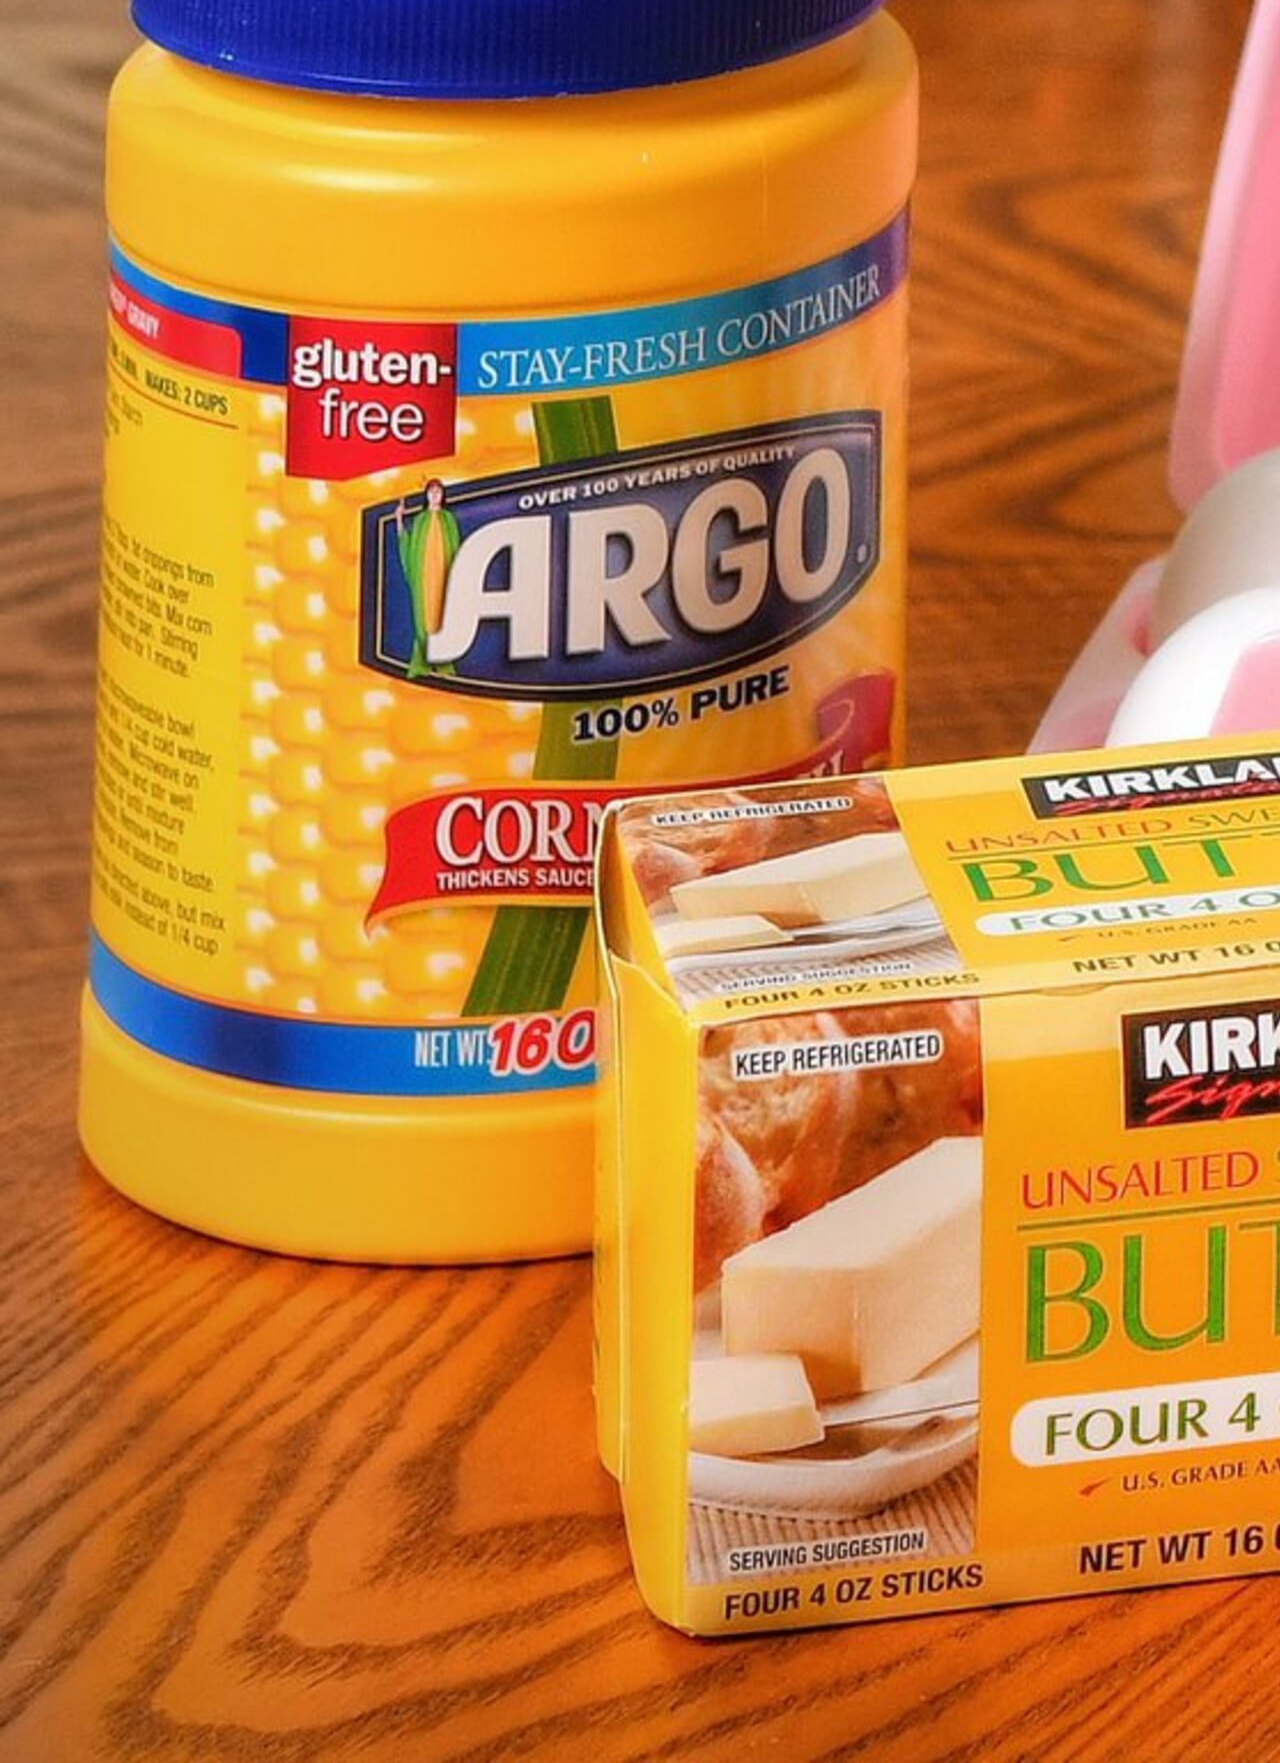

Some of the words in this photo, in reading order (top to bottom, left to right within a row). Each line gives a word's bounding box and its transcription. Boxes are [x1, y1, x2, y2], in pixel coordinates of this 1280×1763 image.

[478, 326, 705, 389] STAY-FRESH
[717, 264, 880, 355] CONTAINER
[292, 338, 452, 389] gluten-
[184, 386, 192, 406] 2
[194, 388, 229, 416] CUPS
[319, 391, 424, 441] free
[519, 487, 576, 511] OVER
[582, 479, 619, 497] 100
[625, 465, 690, 491] YEARS
[695, 459, 719, 476] OF
[724, 445, 796, 472] QUALITY
[427, 447, 850, 664] ARGO
[572, 697, 679, 742] 100%
[691, 665, 790, 721] PURE
[655, 811, 704, 825] KEEP
[709, 798, 851, 821] REFRIGERATED
[946, 819, 1173, 855] UNSALTED
[436, 868, 531, 892] THICKENS
[1010, 902, 1180, 933] FOUR
[1190, 898, 1219, 914] 4
[1073, 958, 1136, 974] NET
[1150, 951, 1212, 967] WT
[1216, 943, 1256, 958] 16
[724, 990, 802, 1010] FOUR
[808, 986, 827, 997] 4
[834, 982, 872, 996] OZ
[879, 973, 982, 991] STICKS
[414, 1031, 450, 1067] NET
[735, 1048, 785, 1076] KEEP
[792, 1035, 940, 1070] REFRIGERATED
[1020, 1150, 1260, 1210] UNSALTED
[1045, 1398, 1209, 1457] FOUR
[1228, 1392, 1262, 1434] 4
[1121, 1471, 1167, 1493] U.S.
[1170, 1459, 1249, 1486] GRADE
[729, 1546, 807, 1572] SERVING
[812, 1531, 925, 1562] SUGGESTION
[1078, 1539, 1146, 1576] NET
[1156, 1529, 1213, 1561] WT
[1223, 1525, 1265, 1558] 16
[724, 1588, 800, 1620] FOUR
[809, 1583, 826, 1607] 4
[836, 1577, 873, 1604] OZ
[881, 1564, 984, 1599] STICKS
